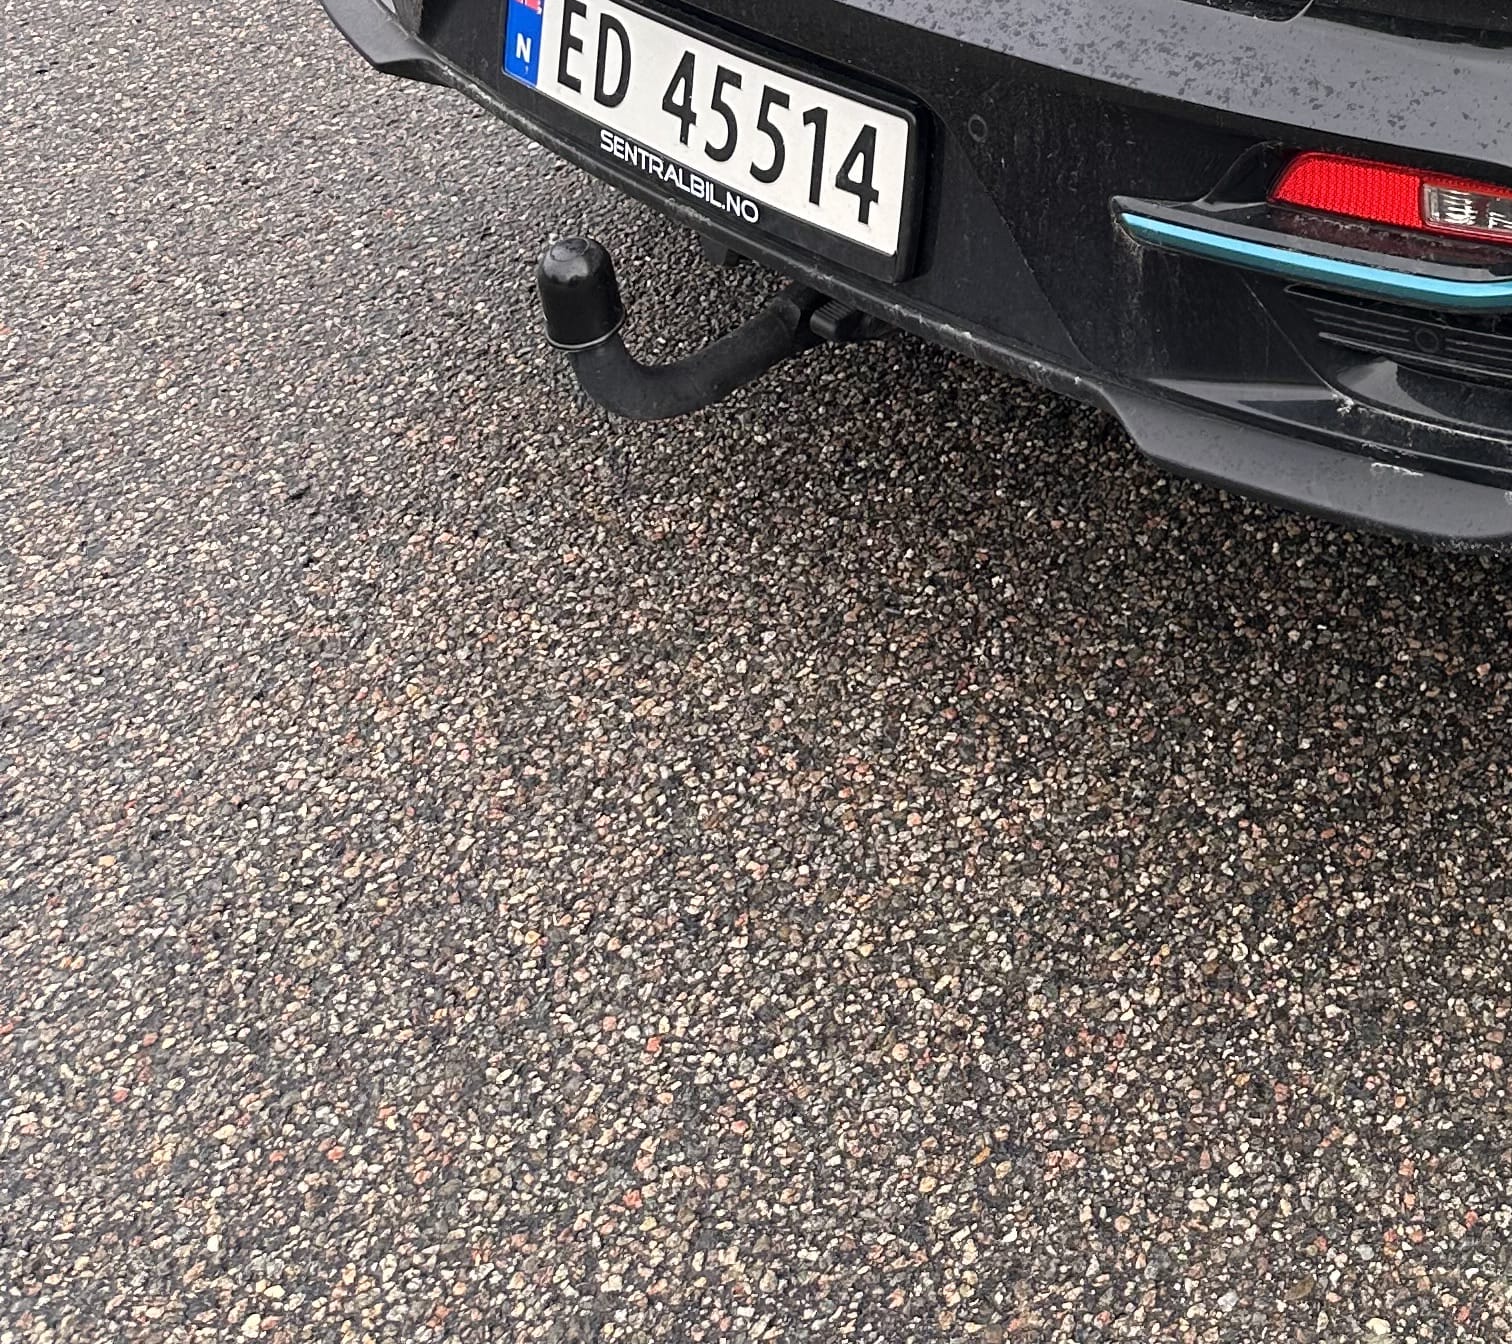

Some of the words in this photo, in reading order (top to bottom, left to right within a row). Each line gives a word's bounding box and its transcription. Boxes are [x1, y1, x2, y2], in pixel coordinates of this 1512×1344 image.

[515, 32, 532, 64] N
[600, 130, 759, 224] SENTRALBIL.NO
[662, 50, 879, 224] 45514
